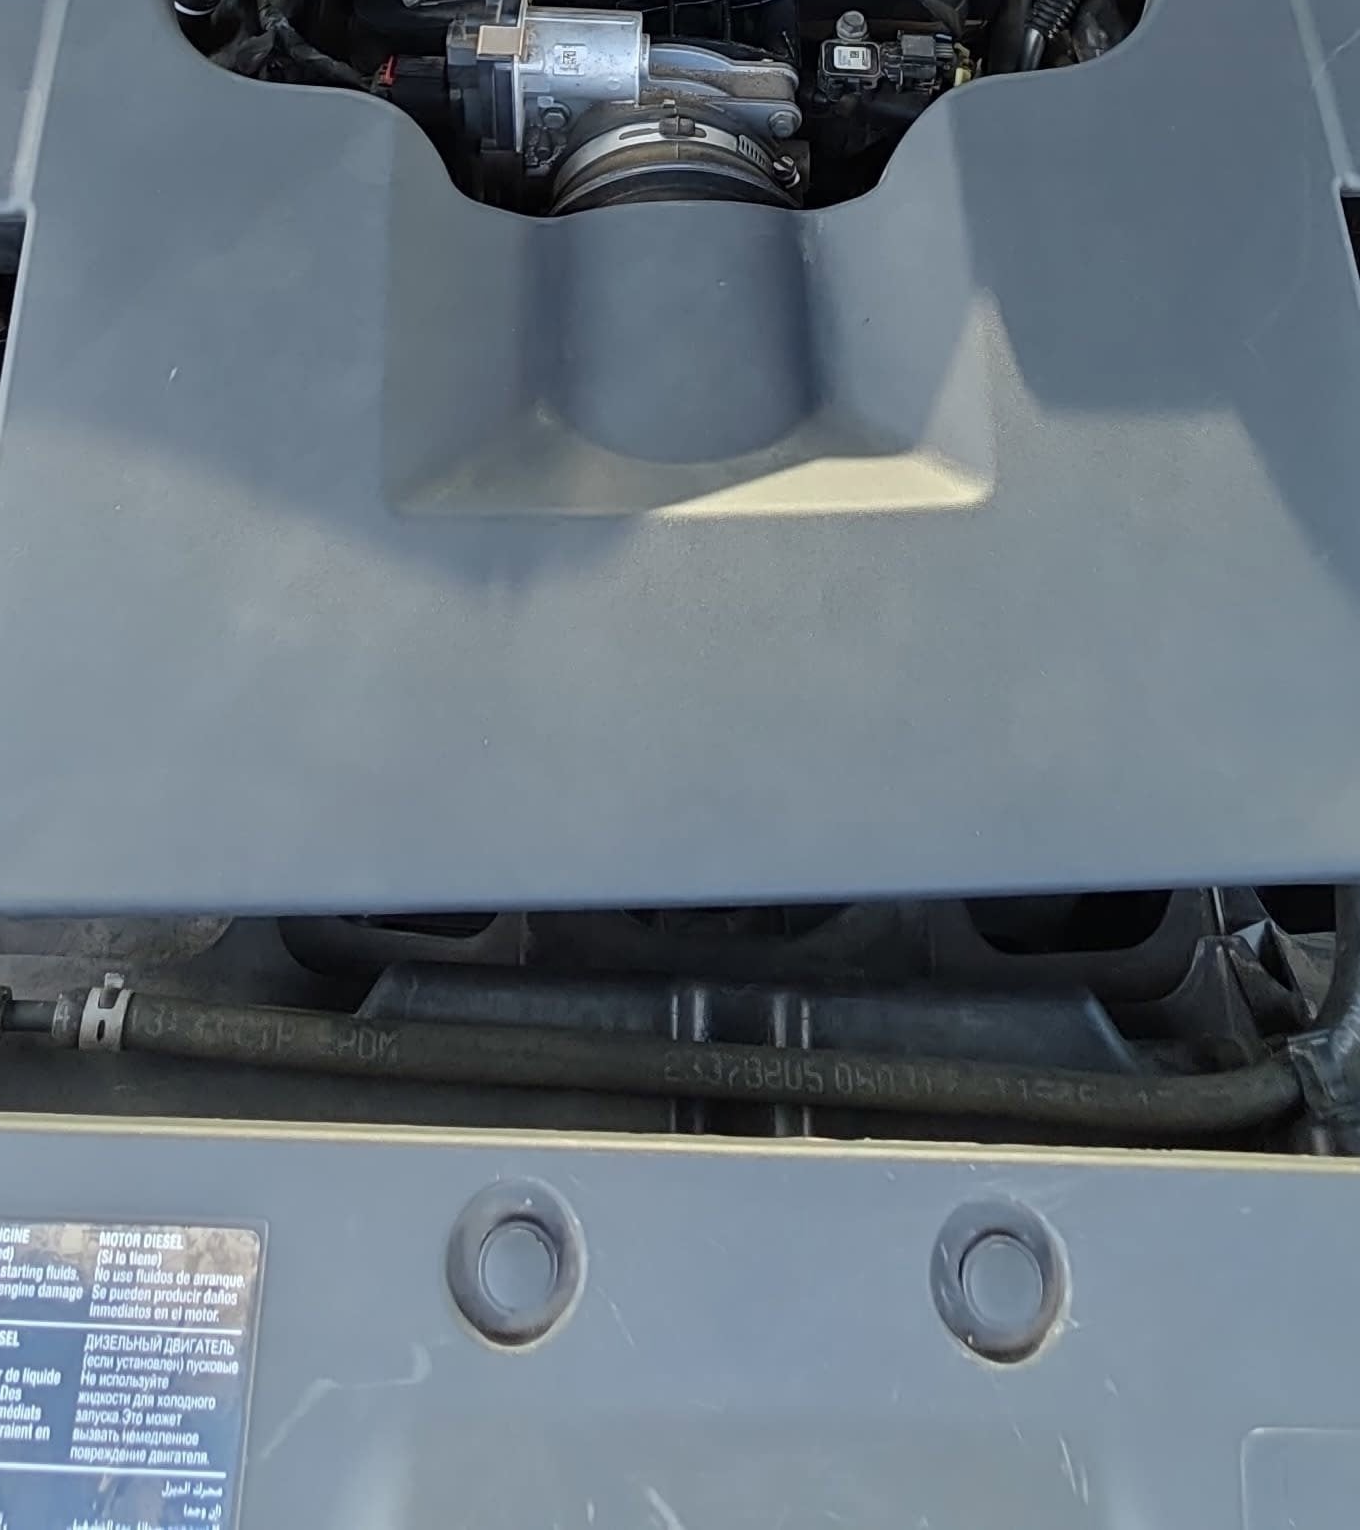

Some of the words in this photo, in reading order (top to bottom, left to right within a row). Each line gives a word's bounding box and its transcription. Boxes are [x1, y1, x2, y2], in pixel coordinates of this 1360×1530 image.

[99, 1231, 141, 1248] MOTOR
[143, 1232, 185, 1250] DIESEL
[96, 1248, 113, 1266] (Si
[115, 1250, 127, 1264] lo
[129, 1250, 163, 1269] tiene)
[0, 1261, 43, 1282] starting
[45, 1263, 80, 1282] fluids.
[94, 1267, 110, 1283] No
[112, 1270, 134, 1283] use
[135, 1267, 174, 1285] fluidos
[176, 1270, 191, 1286] de
[193, 1274, 246, 1289] arranque.
[37, 1282, 84, 1302] damage
[91, 1284, 107, 1300] Se
[108, 1287, 151, 1303] pueden
[153, 1287, 200, 1305] producir
[203, 1288, 238, 1306] daños
[154, 1308, 169, 1320] en
[171, 1305, 183, 1321] el
[184, 1308, 220, 1323] motor.
[84, 1333, 163, 1353] ДИЗЕЛЬНЫЙ
[163, 1337, 235, 1356] ДВИГАТЕЛЬ
[82, 1353, 114, 1369] (если
[115, 1356, 185, 1374] установлен)
[186, 1359, 239, 1376] пусковые
[4, 1367, 20, 1382] de
[22, 1367, 62, 1387] liquide
[80, 1370, 97, 1386] Не
[98, 1373, 170, 1391] используйте
[0, 1384, 22, 1401] Des
[77, 1391, 131, 1407] жидкости
[132, 1394, 155, 1409] для
[157, 1396, 217, 1411] холодного
[145, 1412, 183, 1427] может
[34, 1428, 51, 1441] en
[72, 1428, 120, 1443] вызвать
[122, 1429, 200, 1446] немедленное
[147, 1450, 210, 1466] двигателя.
